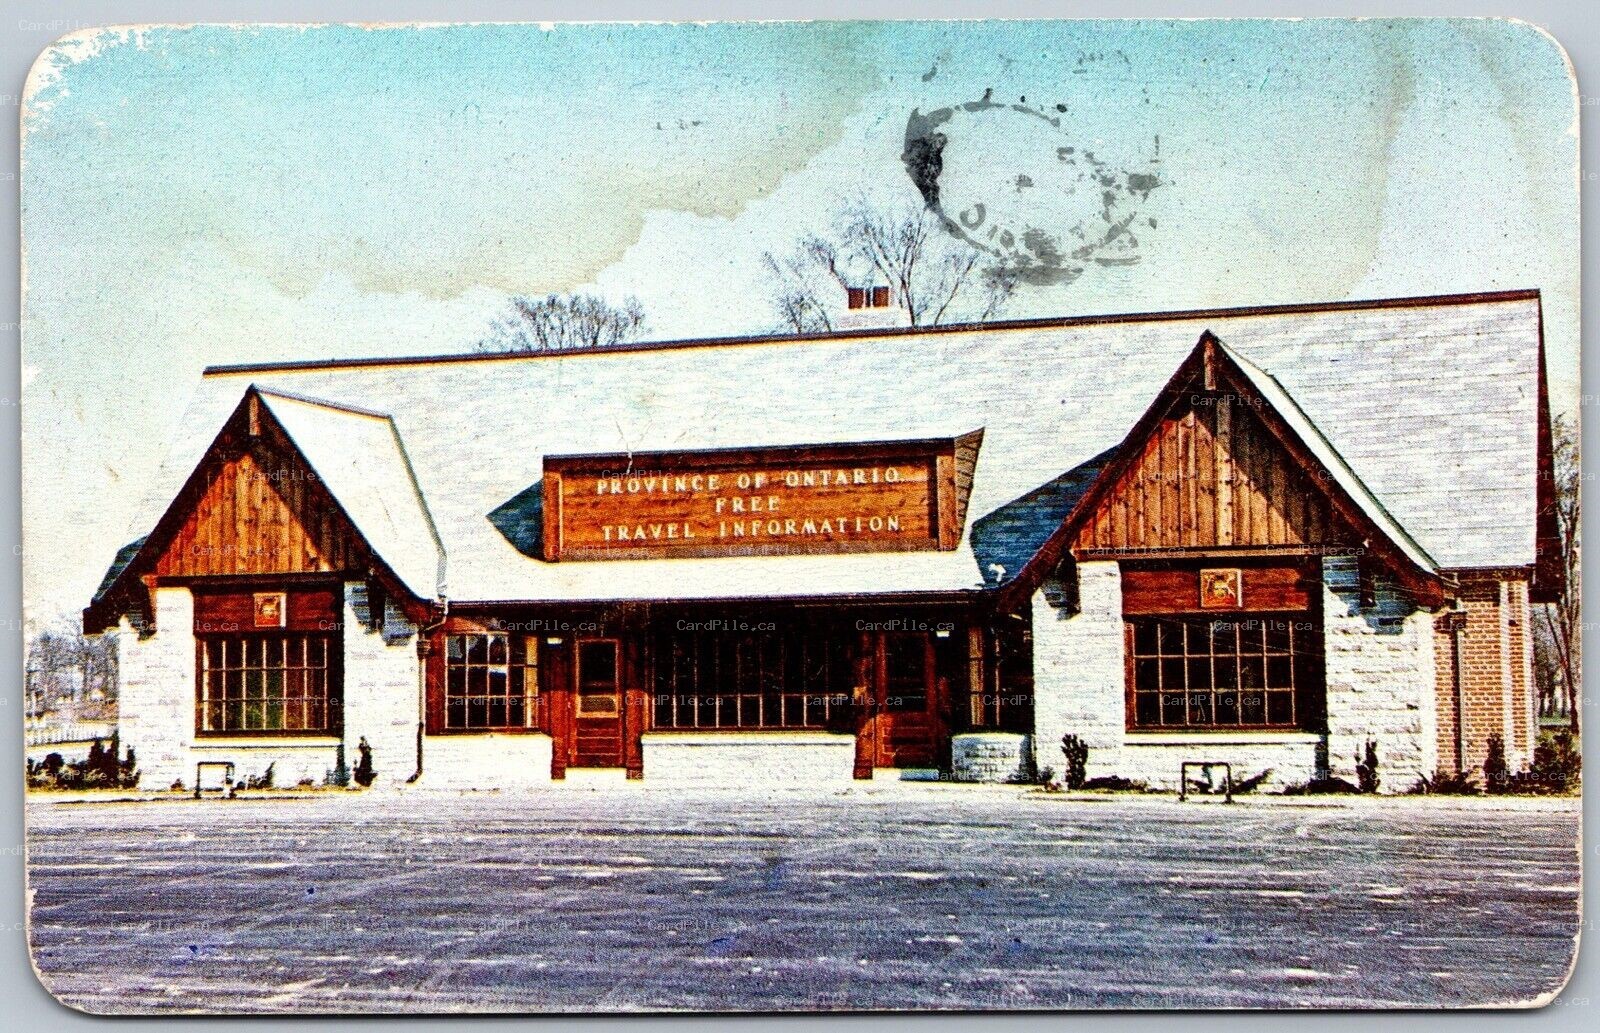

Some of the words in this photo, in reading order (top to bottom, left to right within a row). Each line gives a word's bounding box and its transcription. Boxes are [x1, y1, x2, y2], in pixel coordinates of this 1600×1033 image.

[597, 474, 719, 495] PROVINCE
[737, 472, 769, 489] OF
[785, 466, 900, 487] ONTARIO
[715, 496, 780, 513] FREE
[601, 522, 695, 541] TRAVEL
[719, 515, 900, 538] INFORMATION
